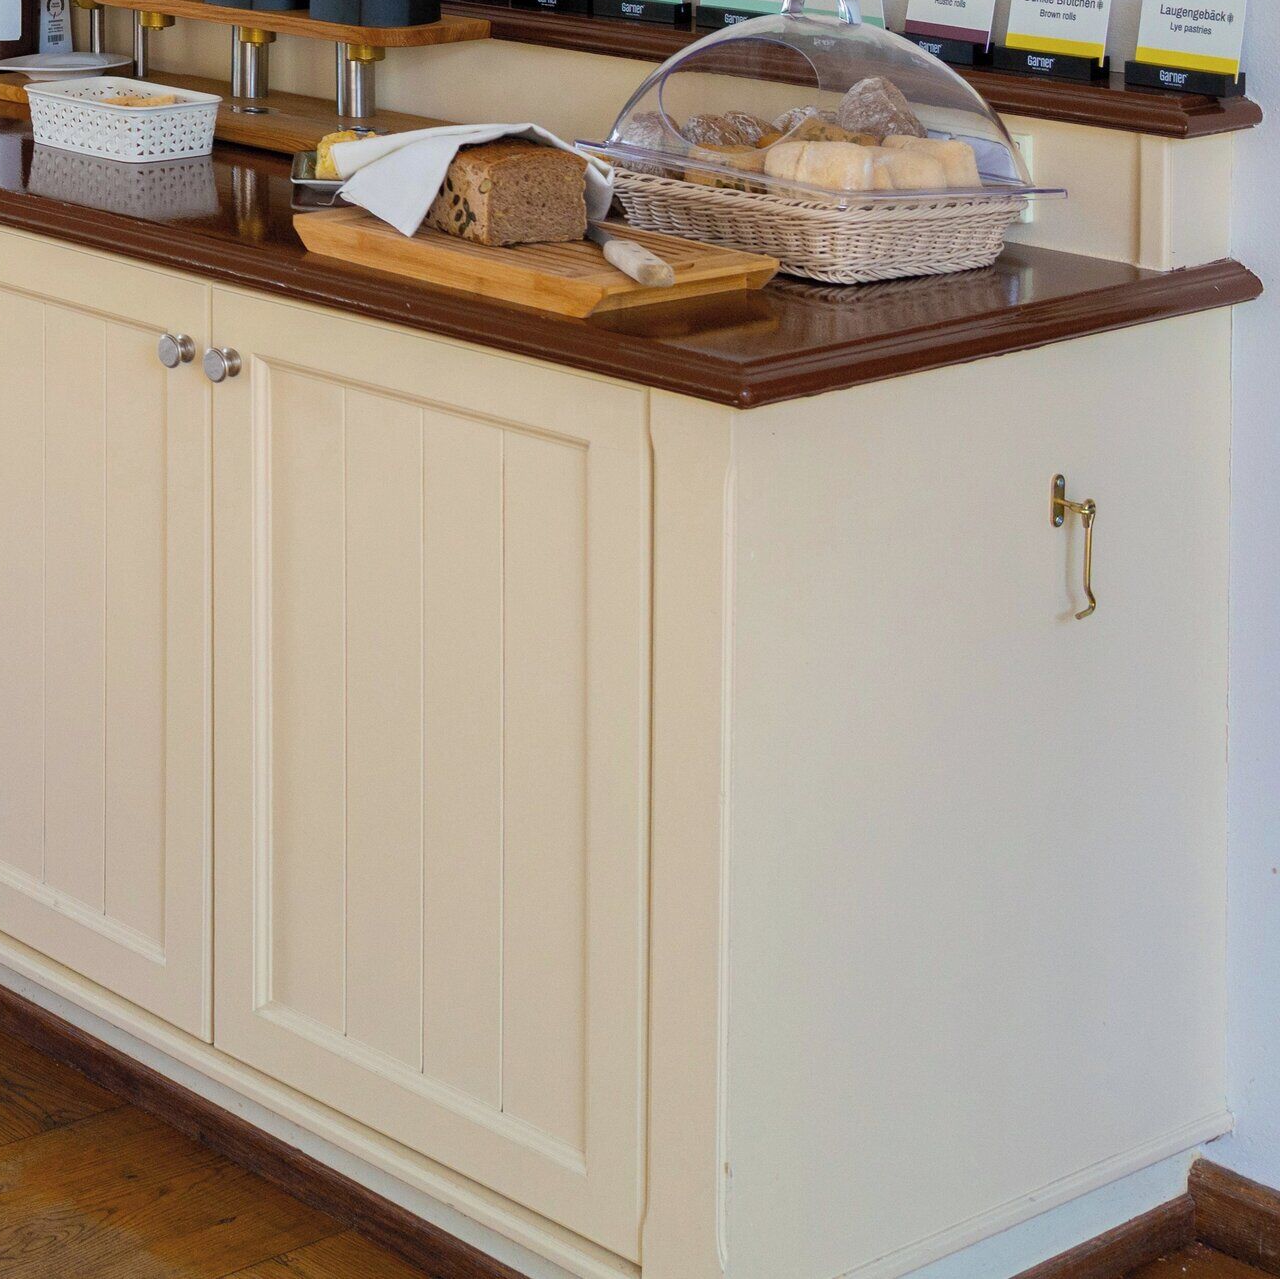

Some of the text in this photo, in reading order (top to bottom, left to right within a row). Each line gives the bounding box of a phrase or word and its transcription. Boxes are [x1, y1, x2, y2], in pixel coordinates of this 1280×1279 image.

[621, 1, 645, 14] Garner
[1039, 8, 1077, 21] Brown rolls
[1159, 3, 1226, 23] Laugengebäck
[1169, 21, 1212, 36] Lye pastries
[1026, 55, 1054, 69] Garner
[1159, 69, 1187, 84] Garner
